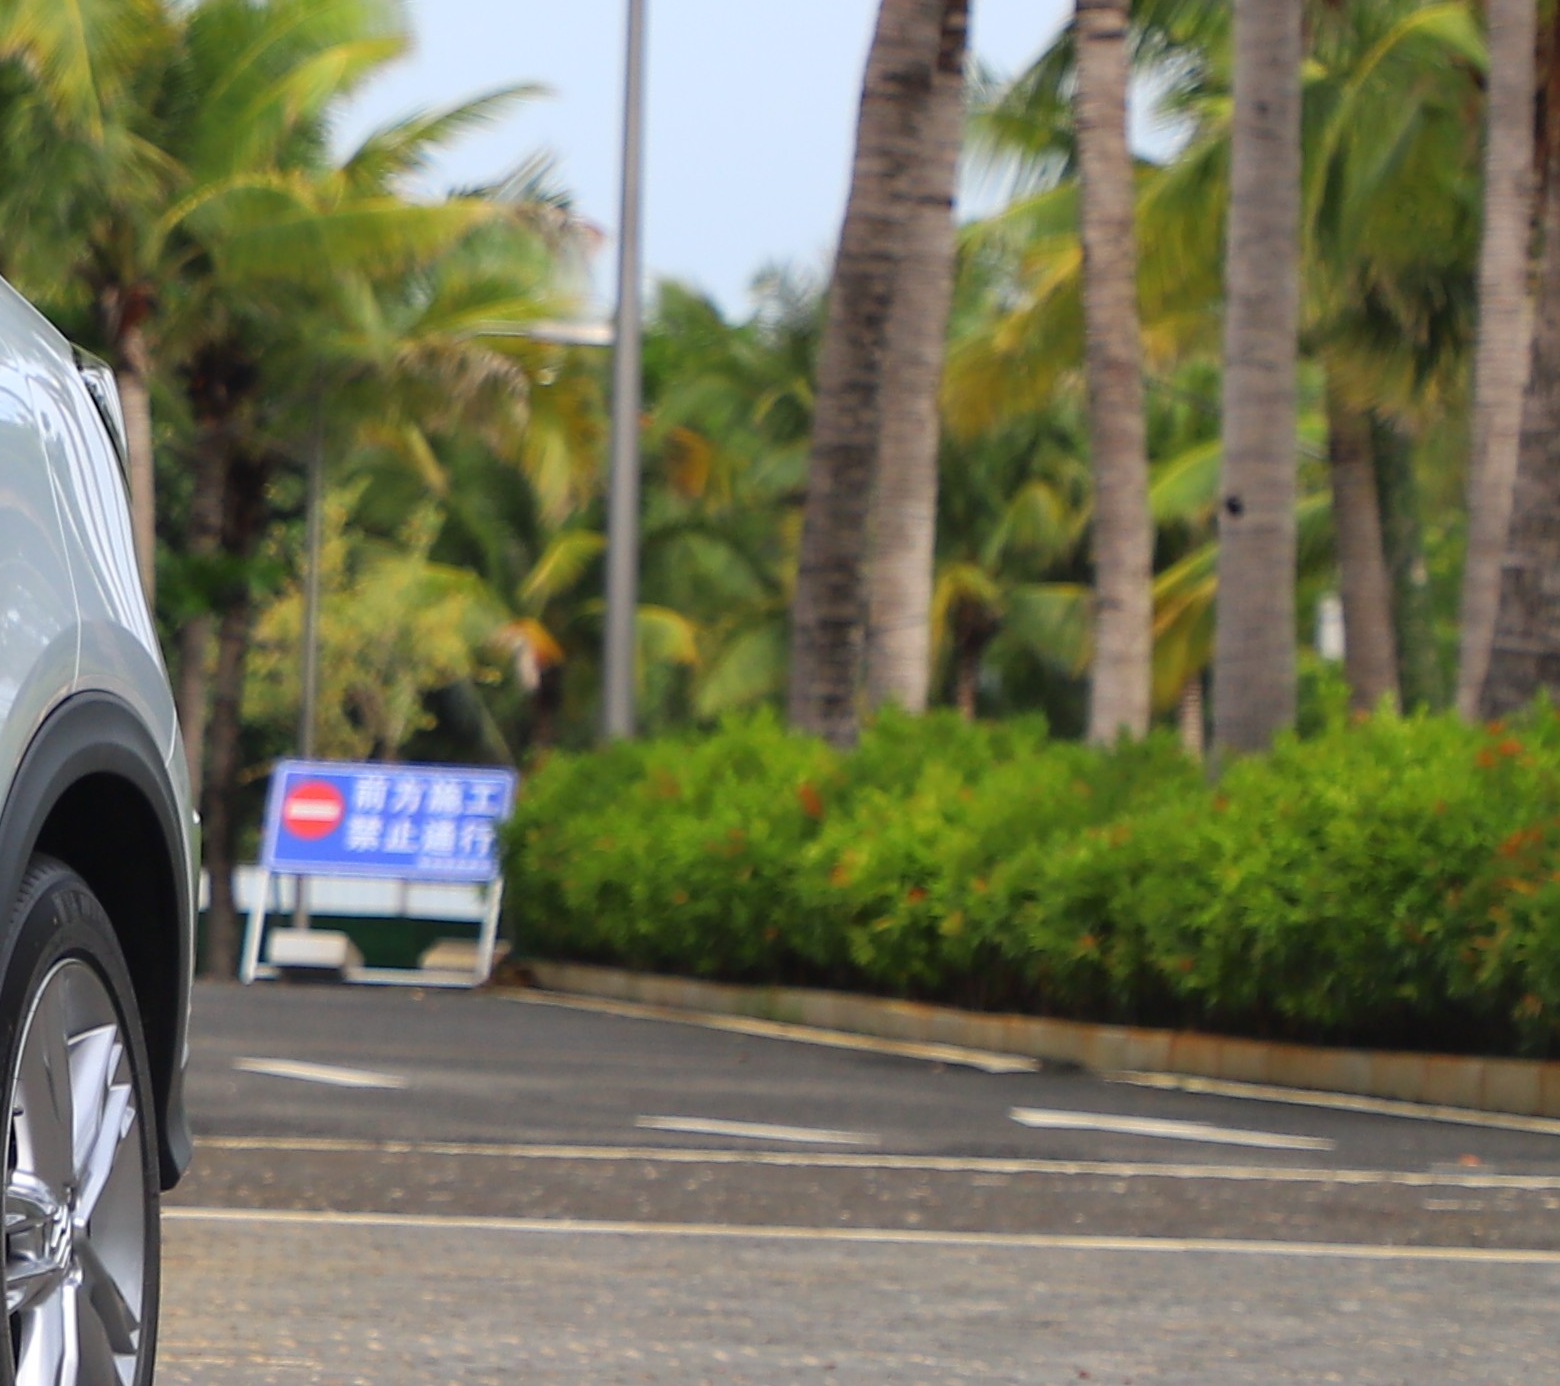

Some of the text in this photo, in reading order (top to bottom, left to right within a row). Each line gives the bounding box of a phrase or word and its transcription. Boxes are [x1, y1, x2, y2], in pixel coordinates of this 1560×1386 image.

[355, 775, 501, 816] 前方施工
[347, 817, 494, 855] 禁止通行
